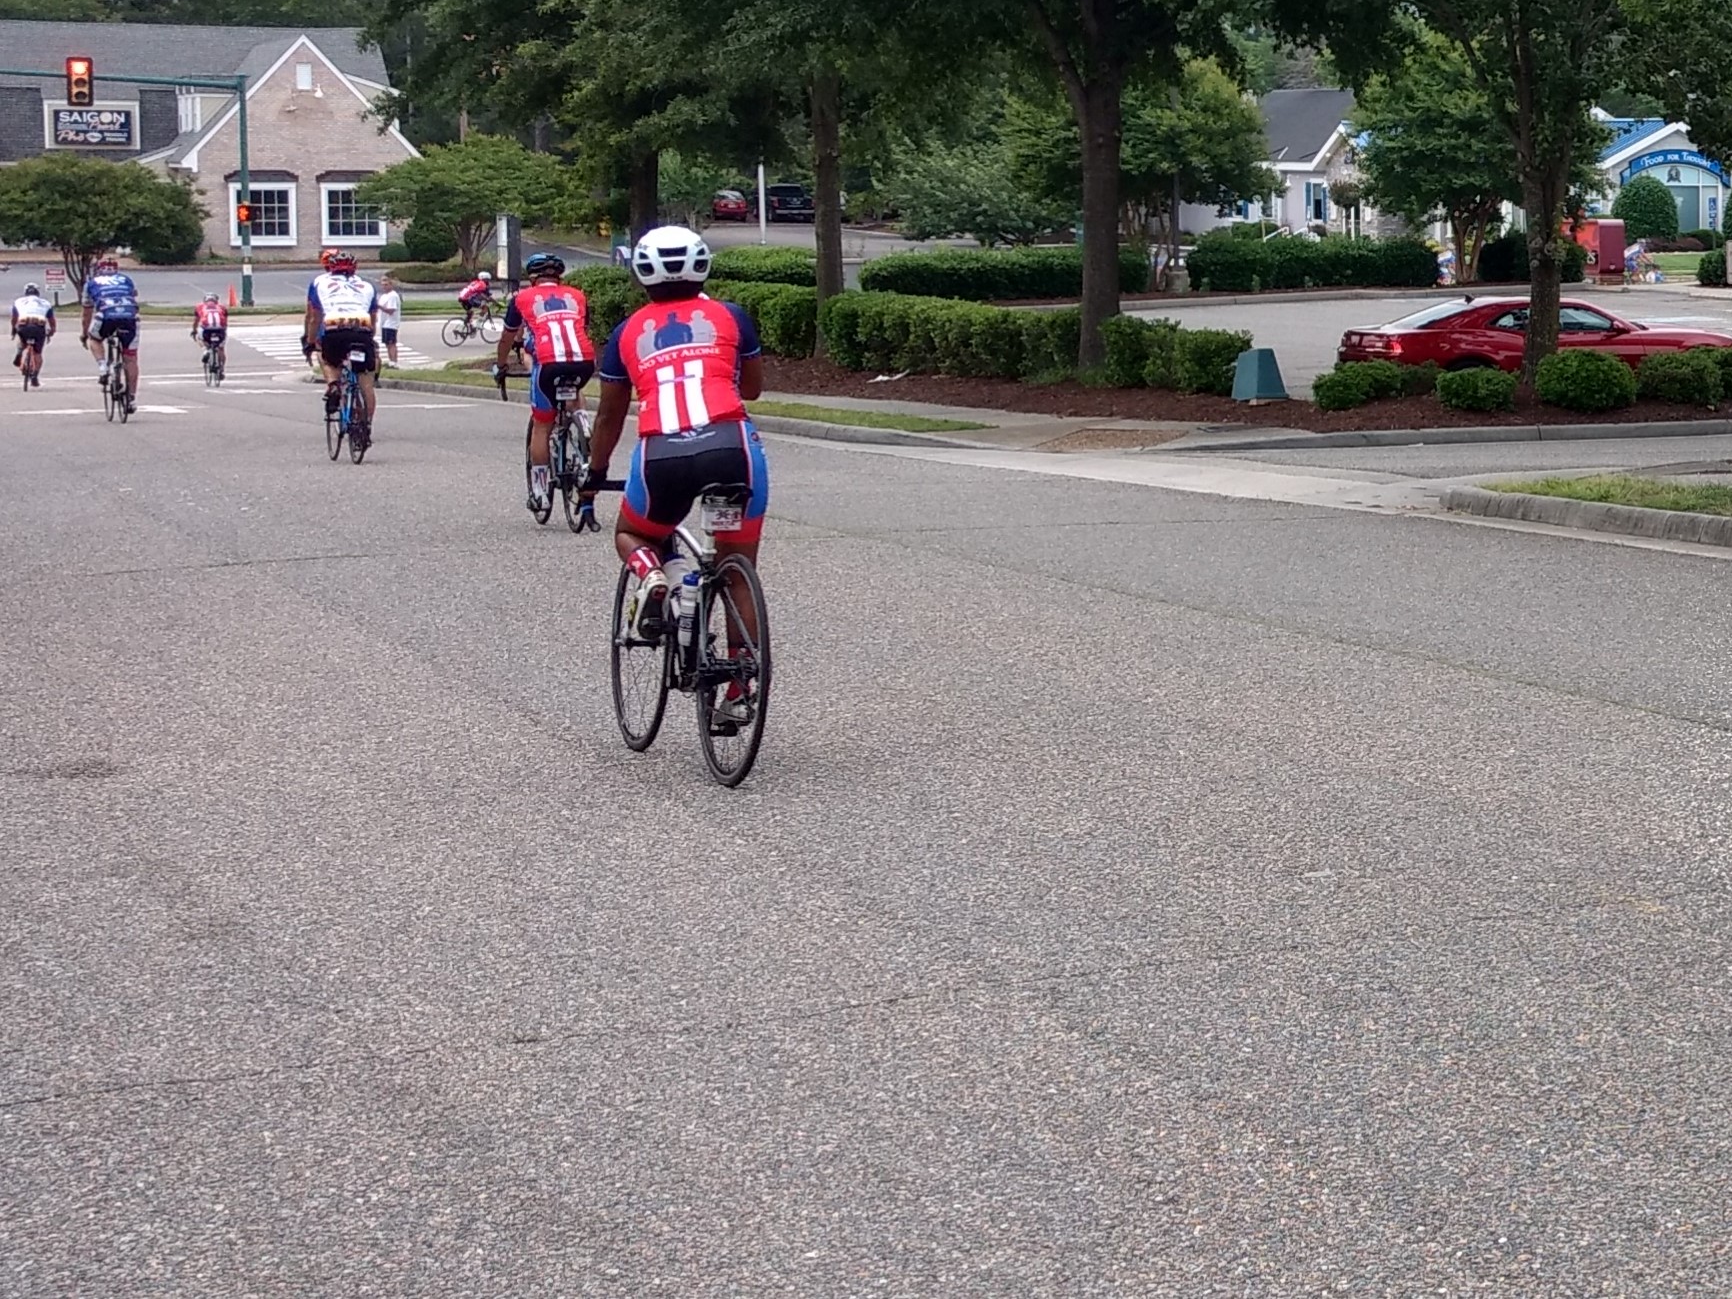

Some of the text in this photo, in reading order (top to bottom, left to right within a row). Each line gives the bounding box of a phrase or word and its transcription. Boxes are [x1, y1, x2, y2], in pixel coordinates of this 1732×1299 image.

[59, 111, 125, 123] SAIGON
[638, 360, 656, 372] NO
[656, 351, 680, 364] VET
